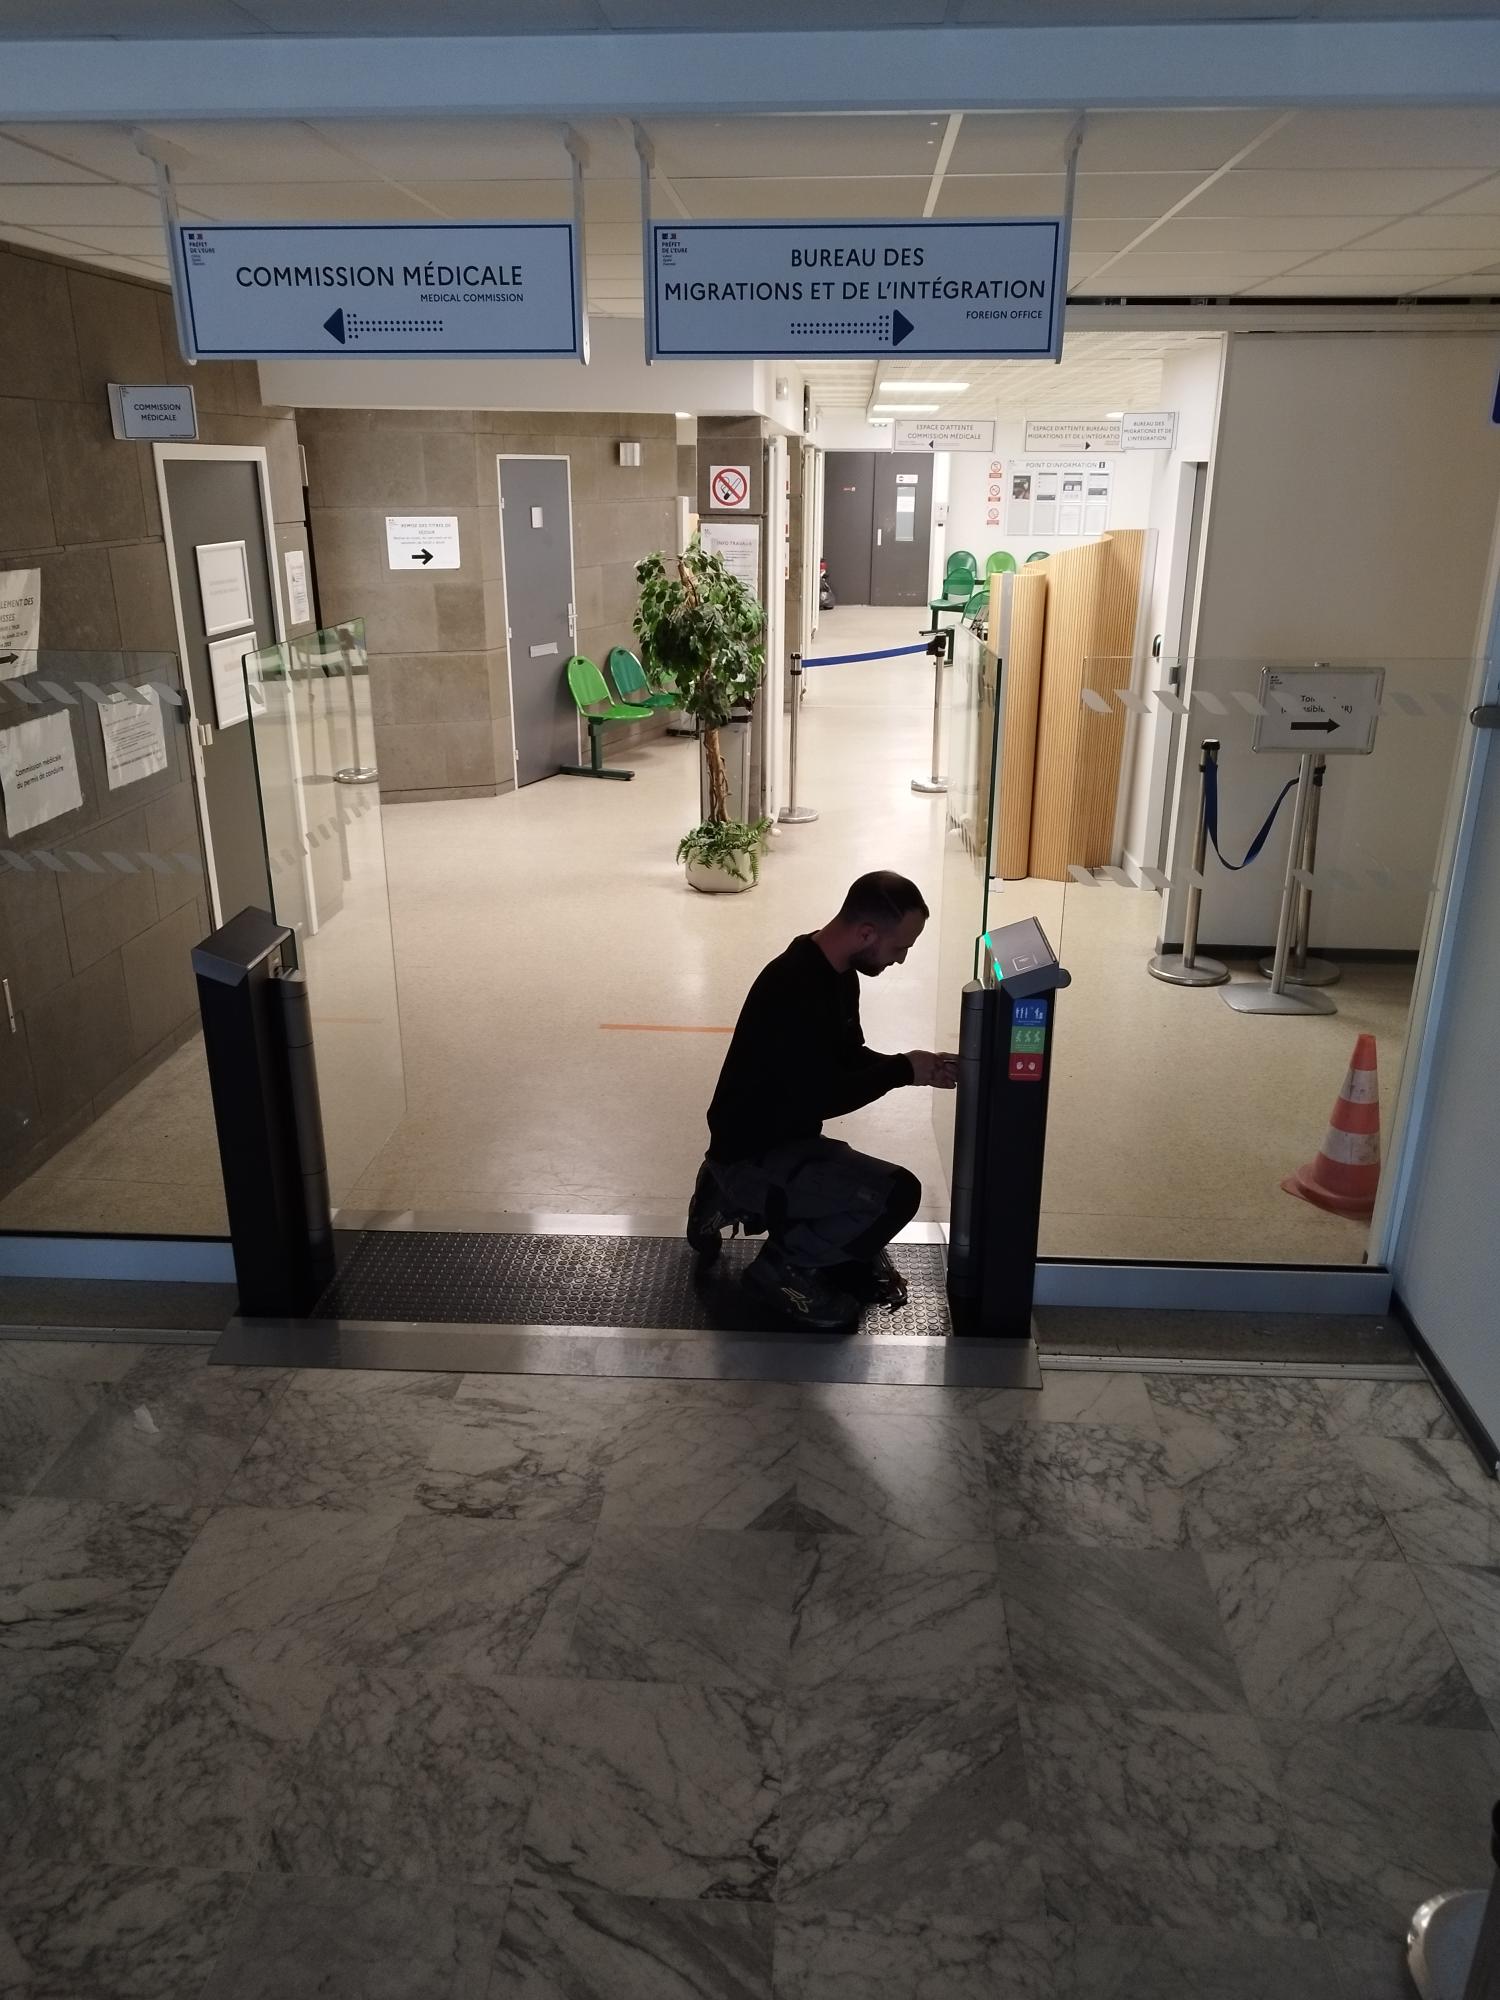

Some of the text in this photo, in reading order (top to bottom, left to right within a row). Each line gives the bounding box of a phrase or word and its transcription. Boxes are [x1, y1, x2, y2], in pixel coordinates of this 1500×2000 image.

[791, 248, 924, 267] BUREAU DES
[236, 261, 523, 287] COMMISSION MÉDICALE
[665, 276, 1046, 301] MIGRATIONS ET DE L'INTÉGRATION
[420, 293, 524, 302] MEDICAL COMMISSION
[966, 310, 1043, 320] FOREIGN OFFICE
[141, 413, 177, 421] MÉDICALE
